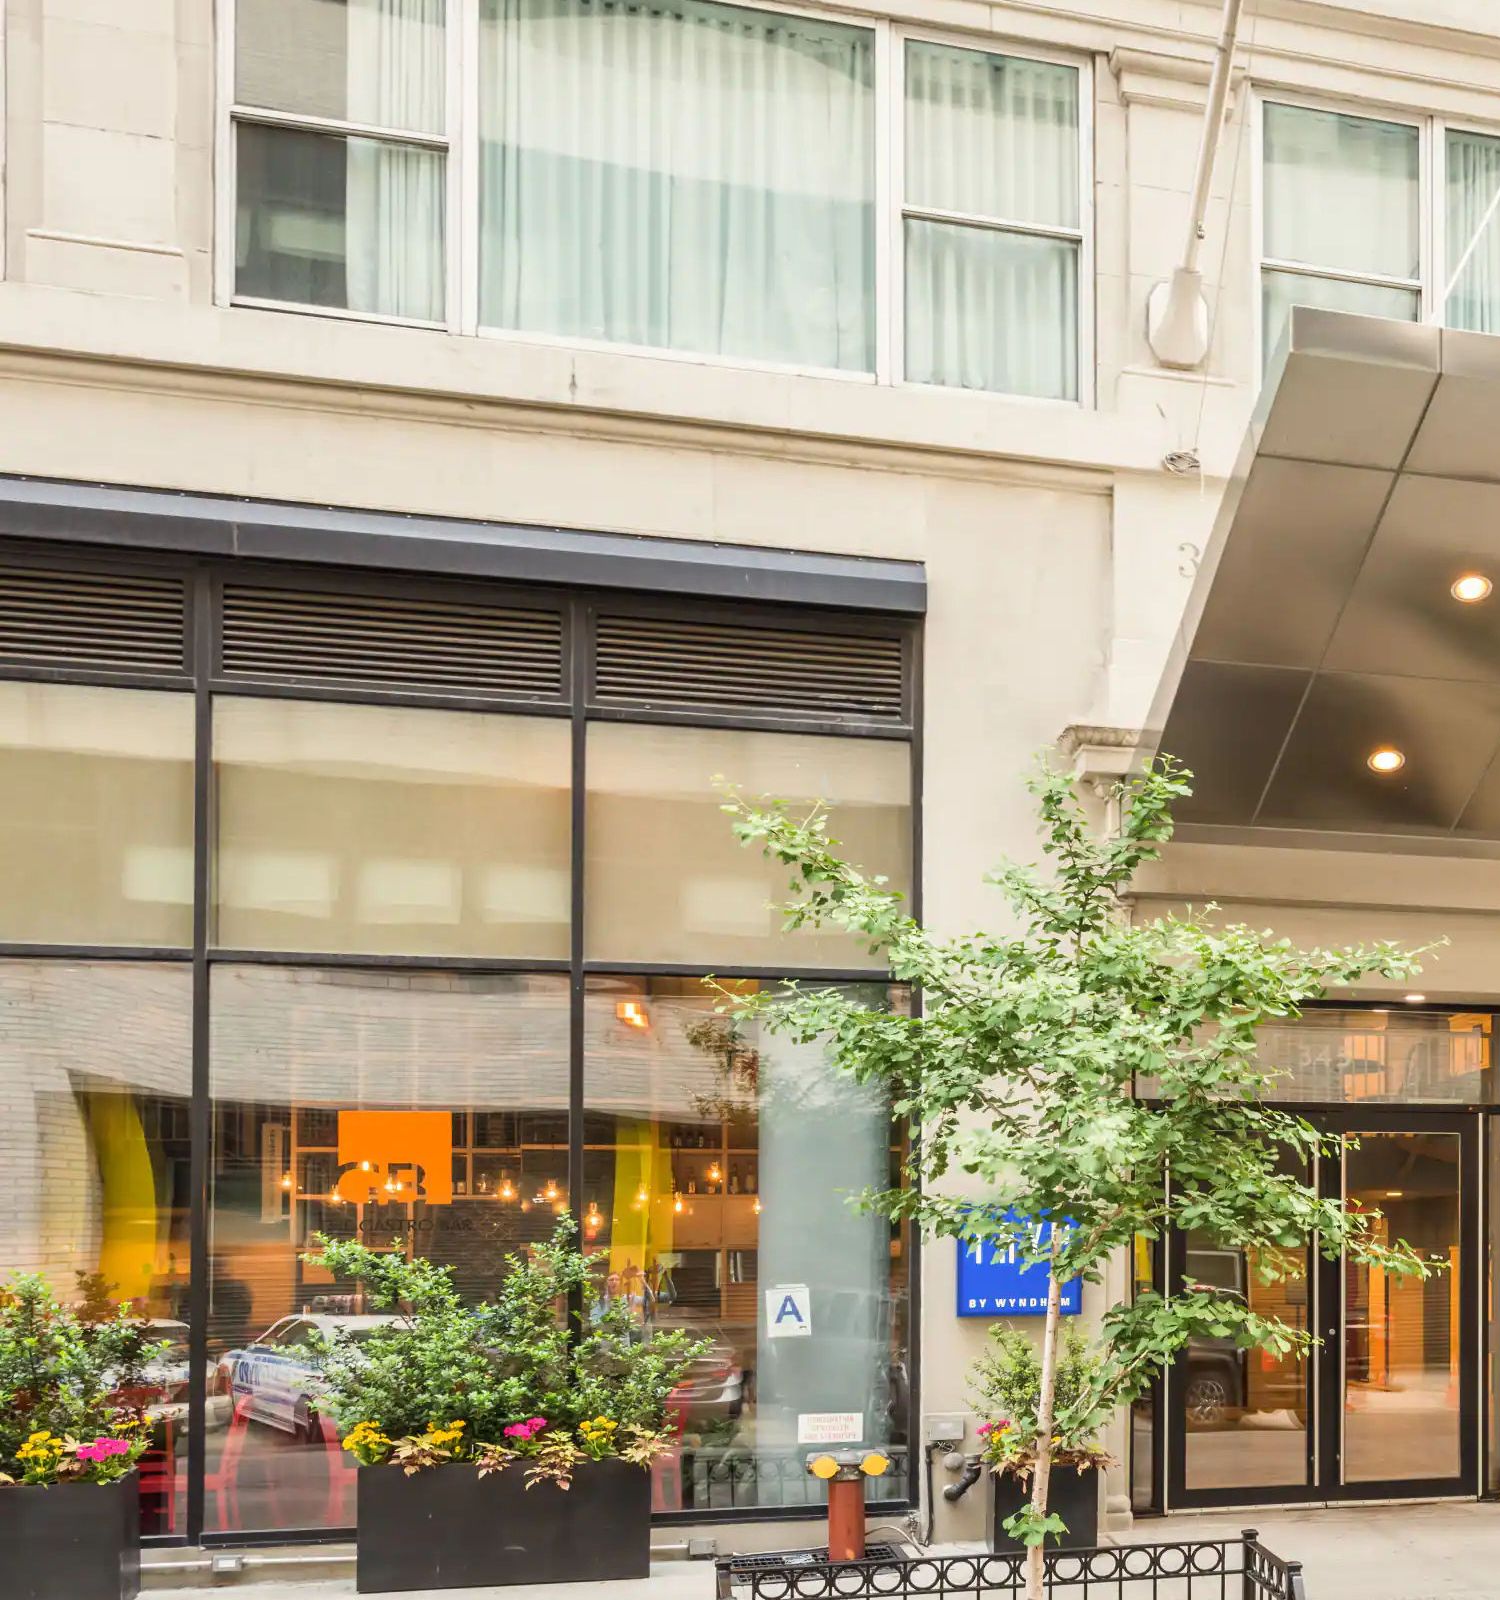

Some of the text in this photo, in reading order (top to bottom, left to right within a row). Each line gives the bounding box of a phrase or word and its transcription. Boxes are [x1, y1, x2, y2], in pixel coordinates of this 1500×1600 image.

[774, 1294, 804, 1324] A
[968, 1297, 1070, 1309] BY WYNDHM
